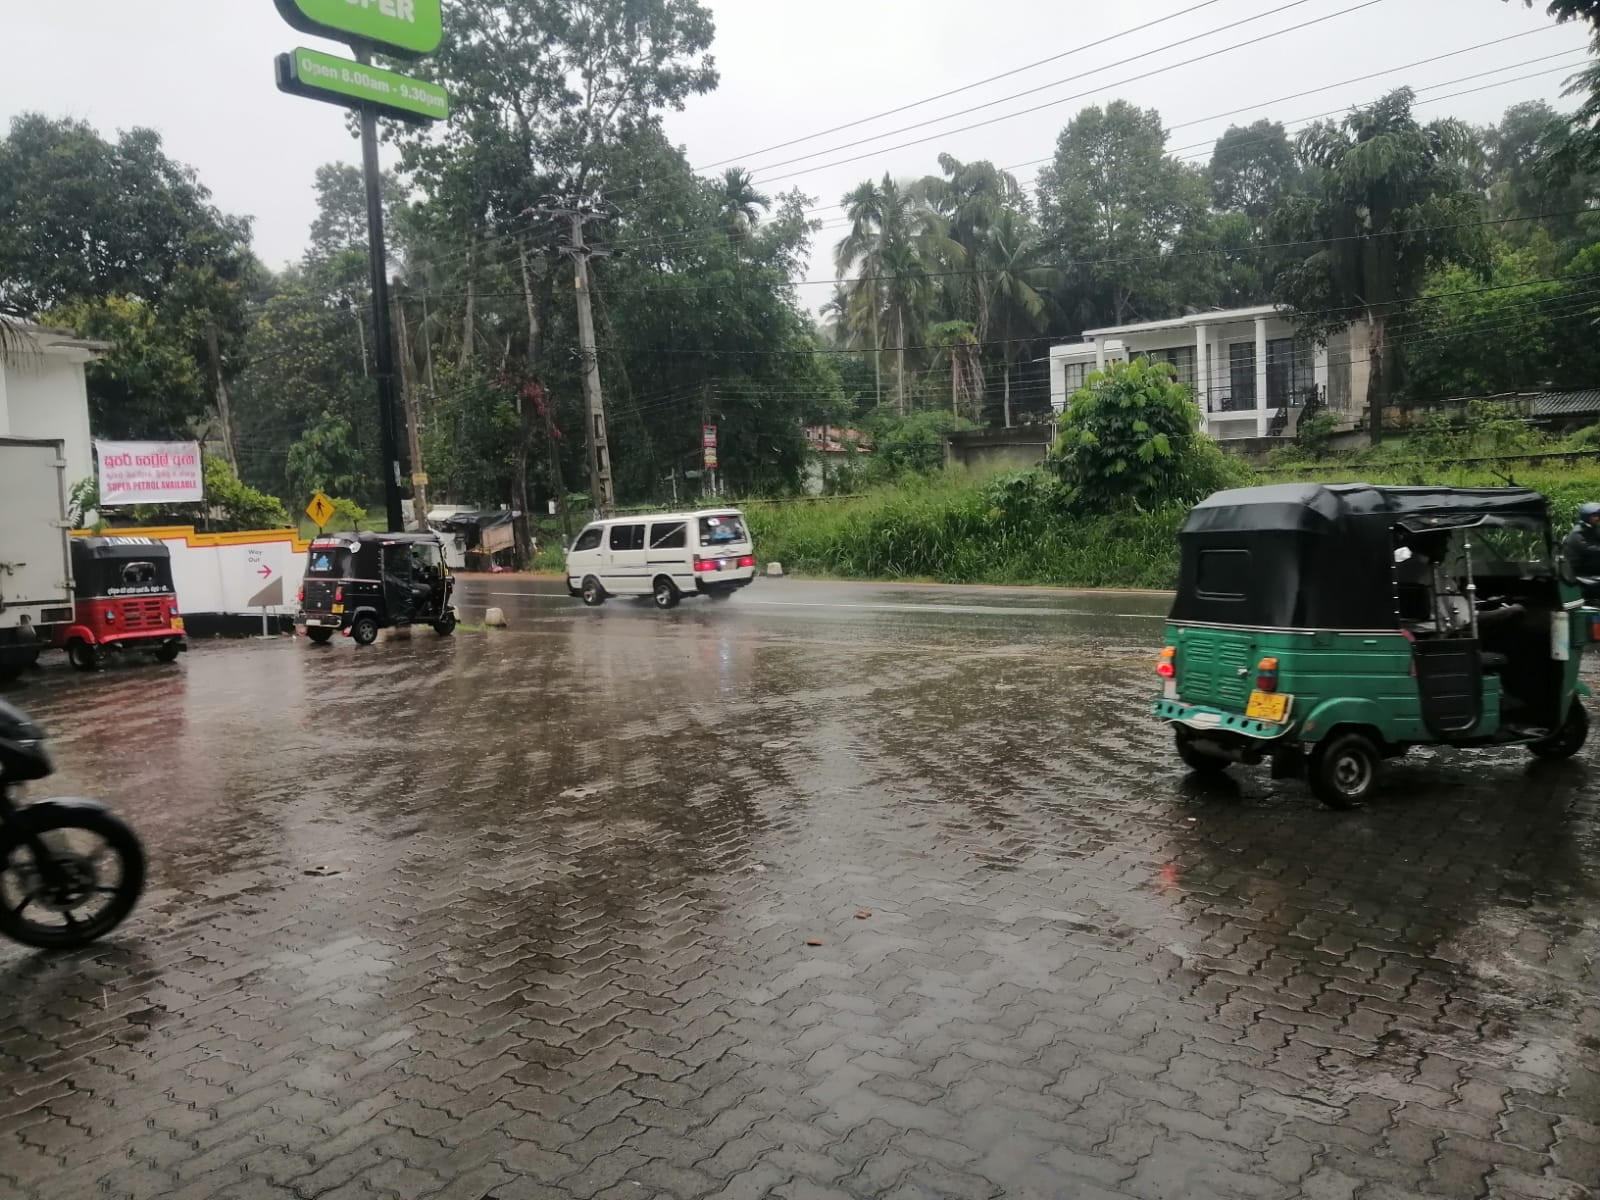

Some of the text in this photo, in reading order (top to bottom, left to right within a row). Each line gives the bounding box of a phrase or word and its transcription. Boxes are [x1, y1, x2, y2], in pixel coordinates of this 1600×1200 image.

[302, 58, 338, 80] Open
[341, 68, 390, 93] 8.00am
[400, 84, 445, 108] 9.30pm
[107, 479, 197, 492] SUPER PETROL AVAILABLE
[248, 549, 262, 557] Way
